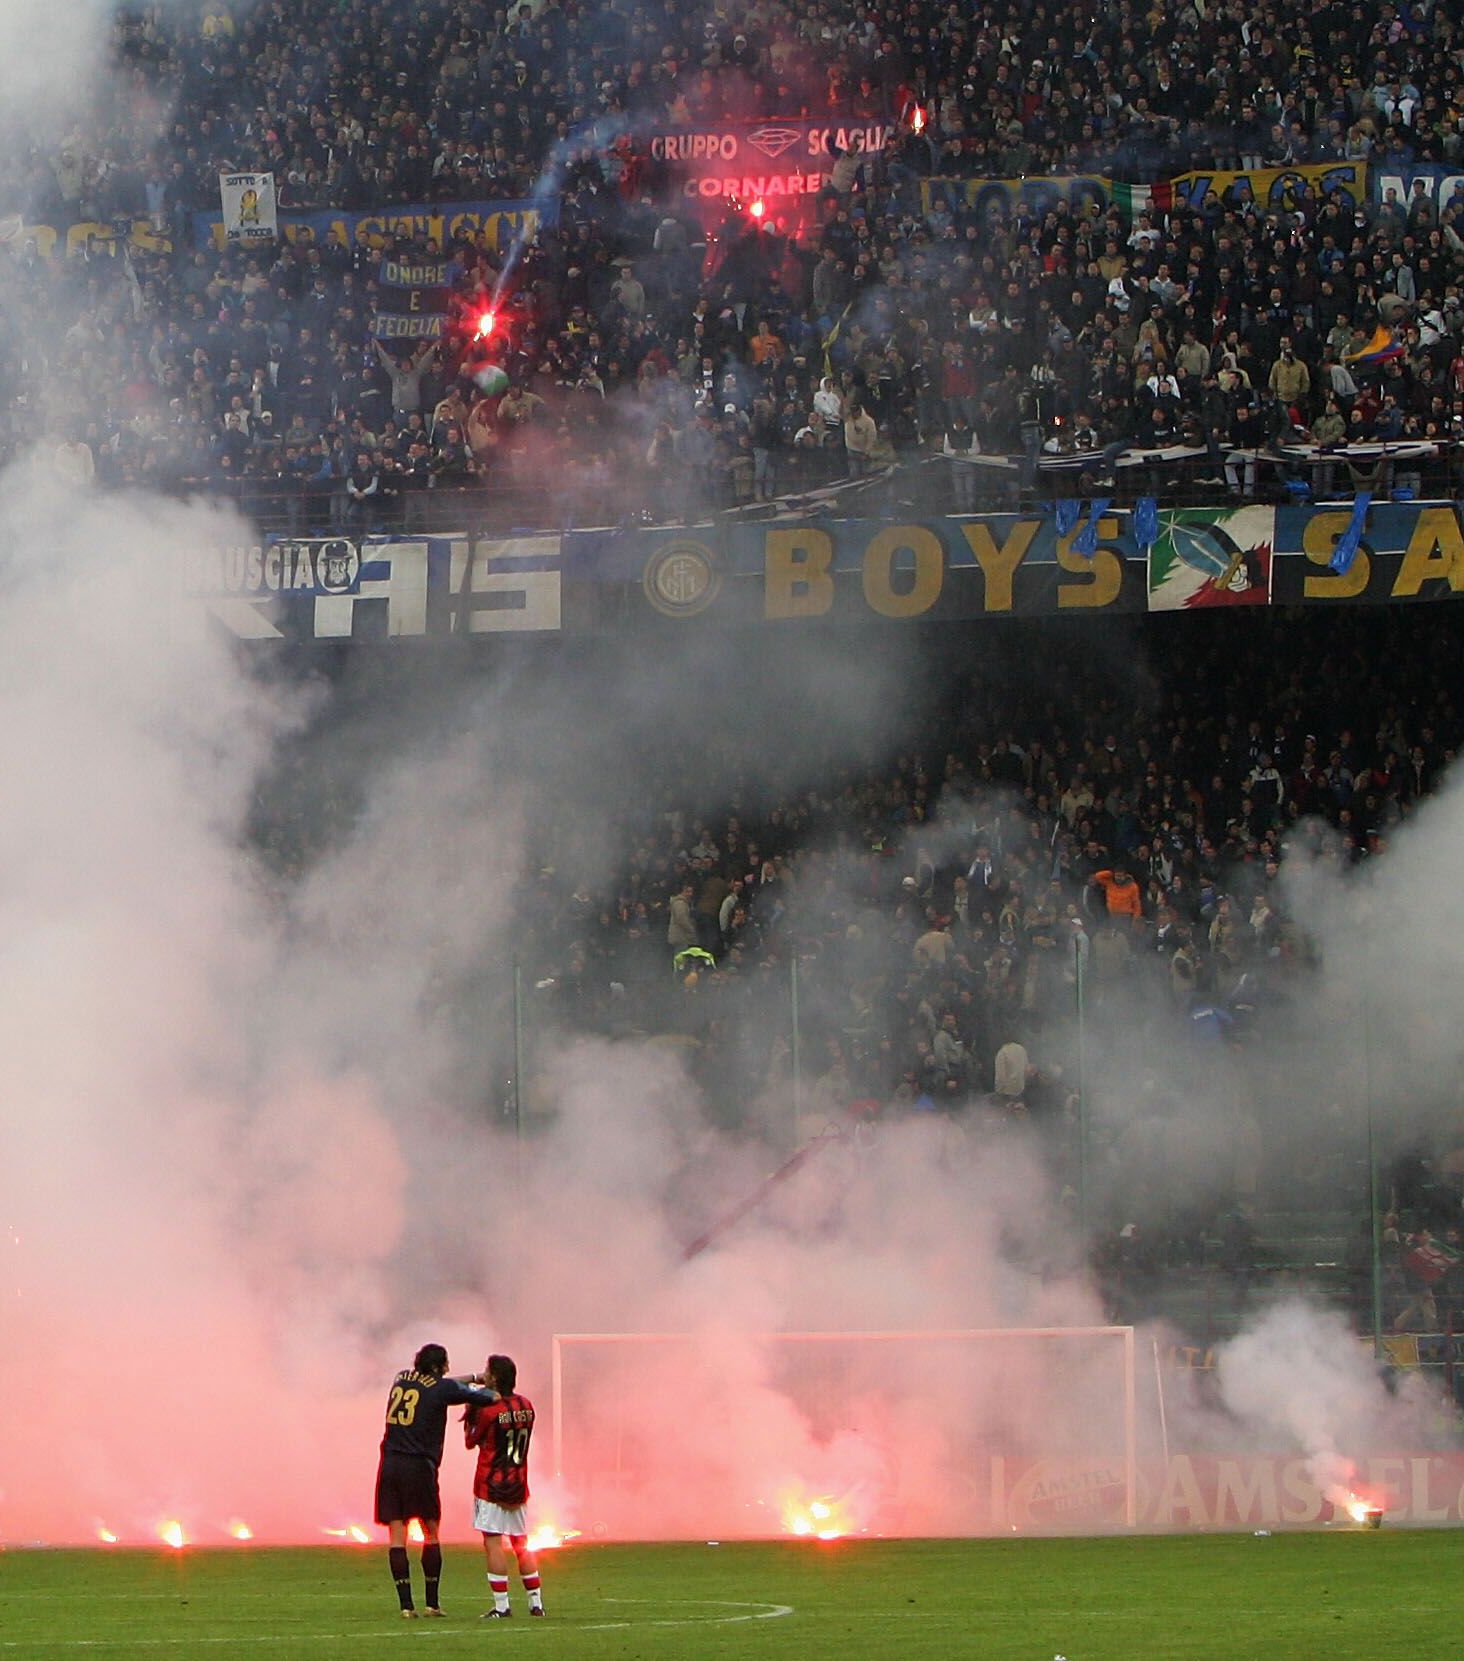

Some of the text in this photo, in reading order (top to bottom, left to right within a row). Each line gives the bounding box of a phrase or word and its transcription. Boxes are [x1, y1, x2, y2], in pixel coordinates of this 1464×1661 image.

[651, 134, 737, 161] GRUPPO
[226, 176, 255, 186] SOTTO
[386, 261, 447, 284] ONORE
[410, 290, 421, 311] E
[764, 507, 1464, 620] BOYS SA
[386, 1386, 420, 1427] 23
[505, 1428, 529, 1465] 10
[1158, 1453, 1444, 1524] AMSEL
